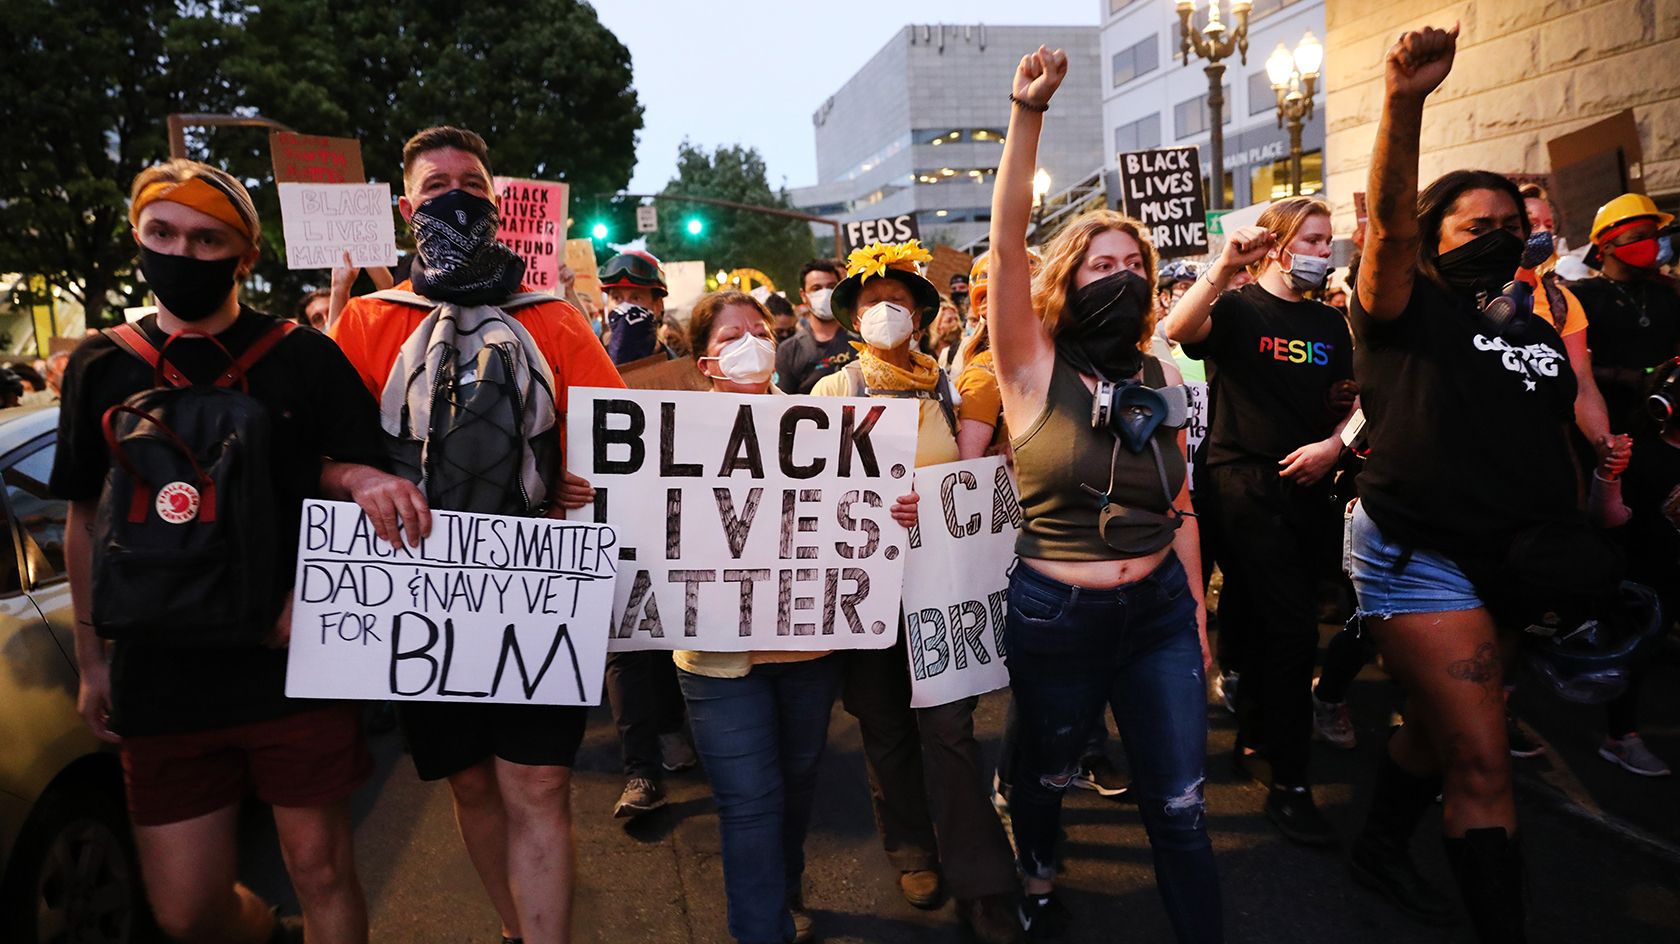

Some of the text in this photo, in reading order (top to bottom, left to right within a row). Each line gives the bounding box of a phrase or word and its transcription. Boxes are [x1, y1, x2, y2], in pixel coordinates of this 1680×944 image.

[1126, 151, 1190, 174] BLACK
[1249, 141, 1284, 163] PLACE
[503, 187, 549, 204] BLACK
[1130, 171, 1193, 199] LIVES
[301, 189, 382, 216] BLACK
[505, 202, 546, 219] LIVES
[1140, 197, 1195, 224] MUST
[303, 220, 378, 242] LIVES
[847, 215, 912, 247] FEDS
[1146, 222, 1207, 248] HRIVE
[291, 243, 392, 266] MATTER!
[1259, 336, 1334, 366] RESIS
[593, 399, 906, 479] BLACK.
[594, 488, 899, 560] LIVES.
[514, 521, 617, 573] MATTER
[301, 564, 394, 607] DAD
[424, 571, 513, 614] NAVY
[522, 575, 594, 618] VET
[608, 568, 886, 639] ATTER.
[320, 610, 587, 702] FOR BLM
